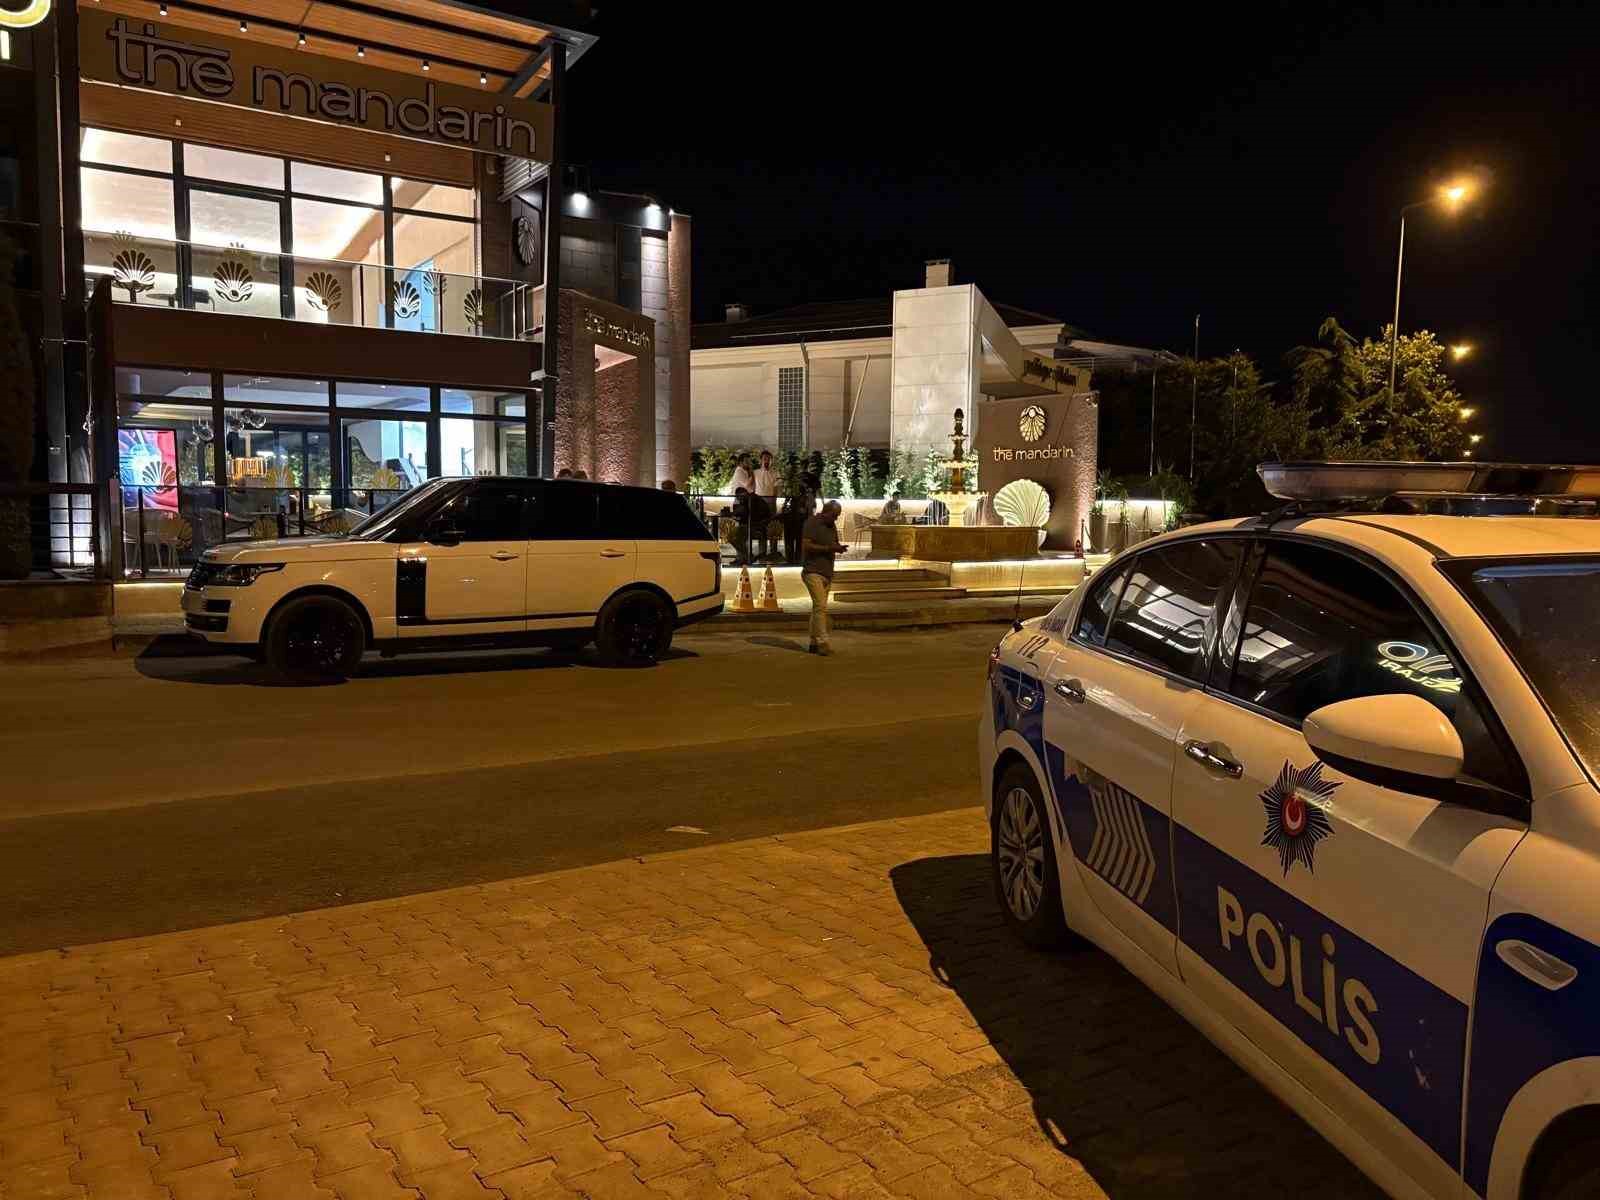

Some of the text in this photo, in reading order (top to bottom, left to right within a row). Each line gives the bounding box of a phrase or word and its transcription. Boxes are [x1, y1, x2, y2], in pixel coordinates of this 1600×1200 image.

[106, 18, 536, 154] the mandarin
[993, 444, 1075, 462] the mandarin
